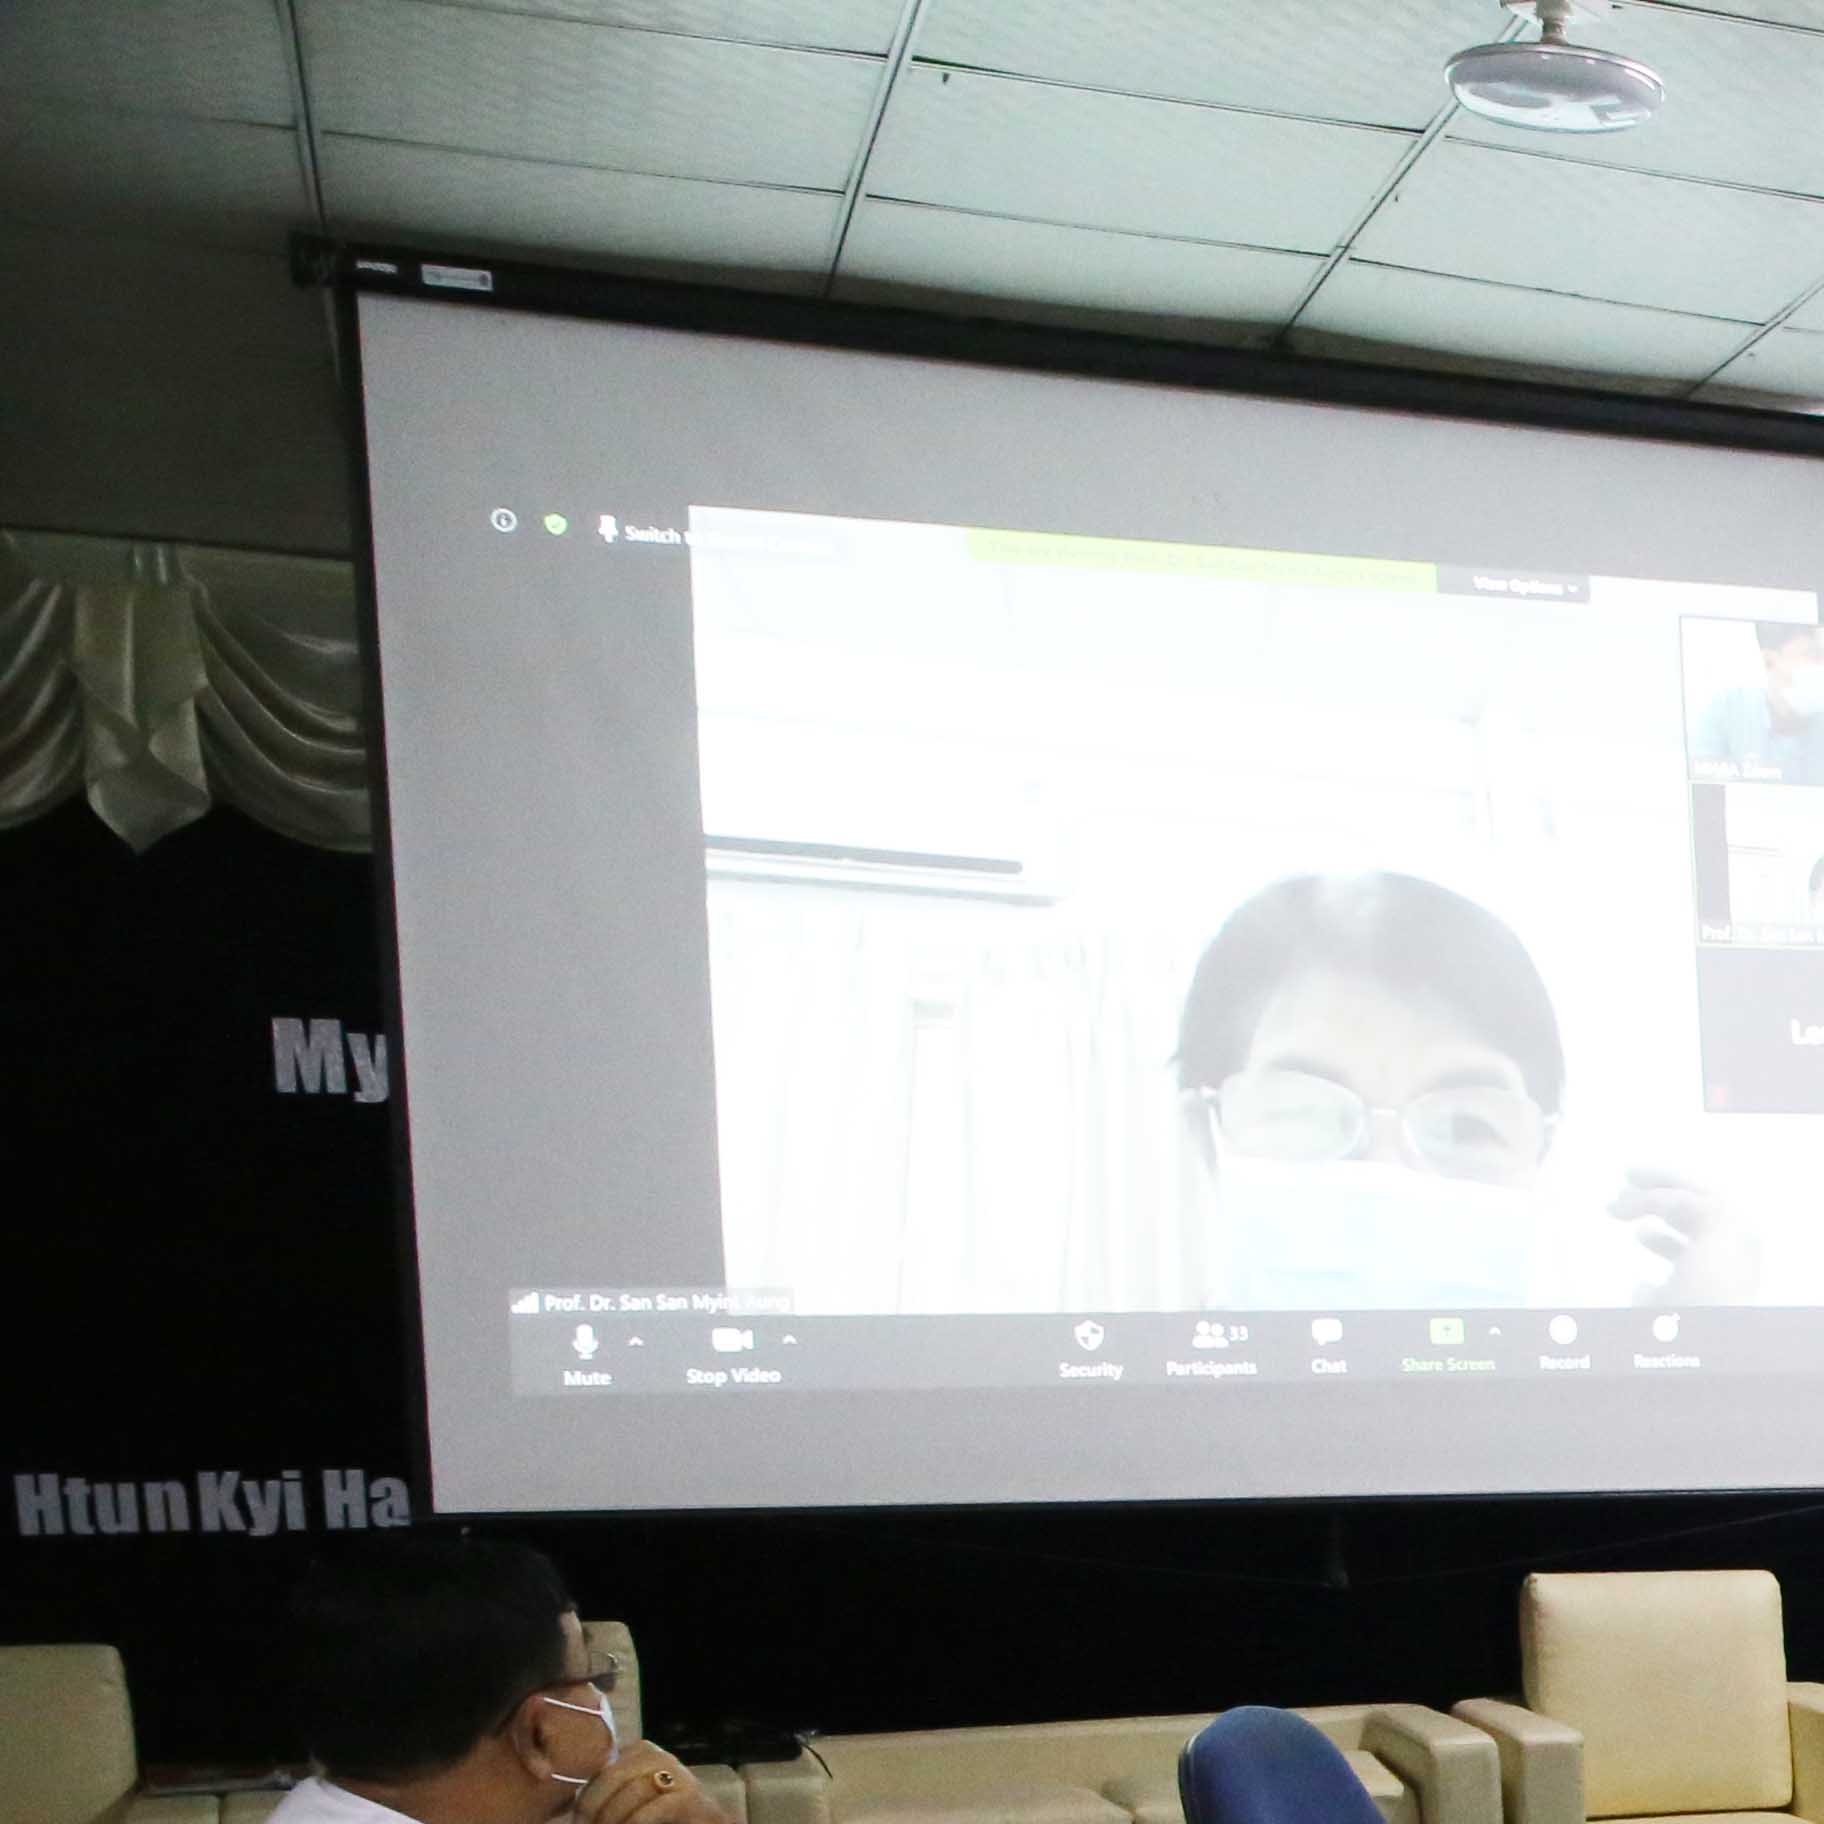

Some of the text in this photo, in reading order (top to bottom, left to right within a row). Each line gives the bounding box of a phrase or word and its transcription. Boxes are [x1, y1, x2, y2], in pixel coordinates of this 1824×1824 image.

[545, 1293, 585, 1311] Prof.
[589, 1293, 616, 1311] Dr.
[620, 1292, 652, 1311] San
[656, 1292, 688, 1311] San
[1166, 1360, 1258, 1379] Participants
[1311, 1358, 1348, 1375] Chat
[1401, 1357, 1497, 1372] Share Screen
[1538, 1354, 1591, 1370] Record
[1633, 1353, 1702, 1369] Reactions
[563, 1370, 612, 1386] Mute
[686, 1366, 782, 1387] Stop Video
[1058, 1361, 1124, 1381] Security
[13, 1472, 191, 1537] Htun
[197, 1470, 307, 1537] Kyi
